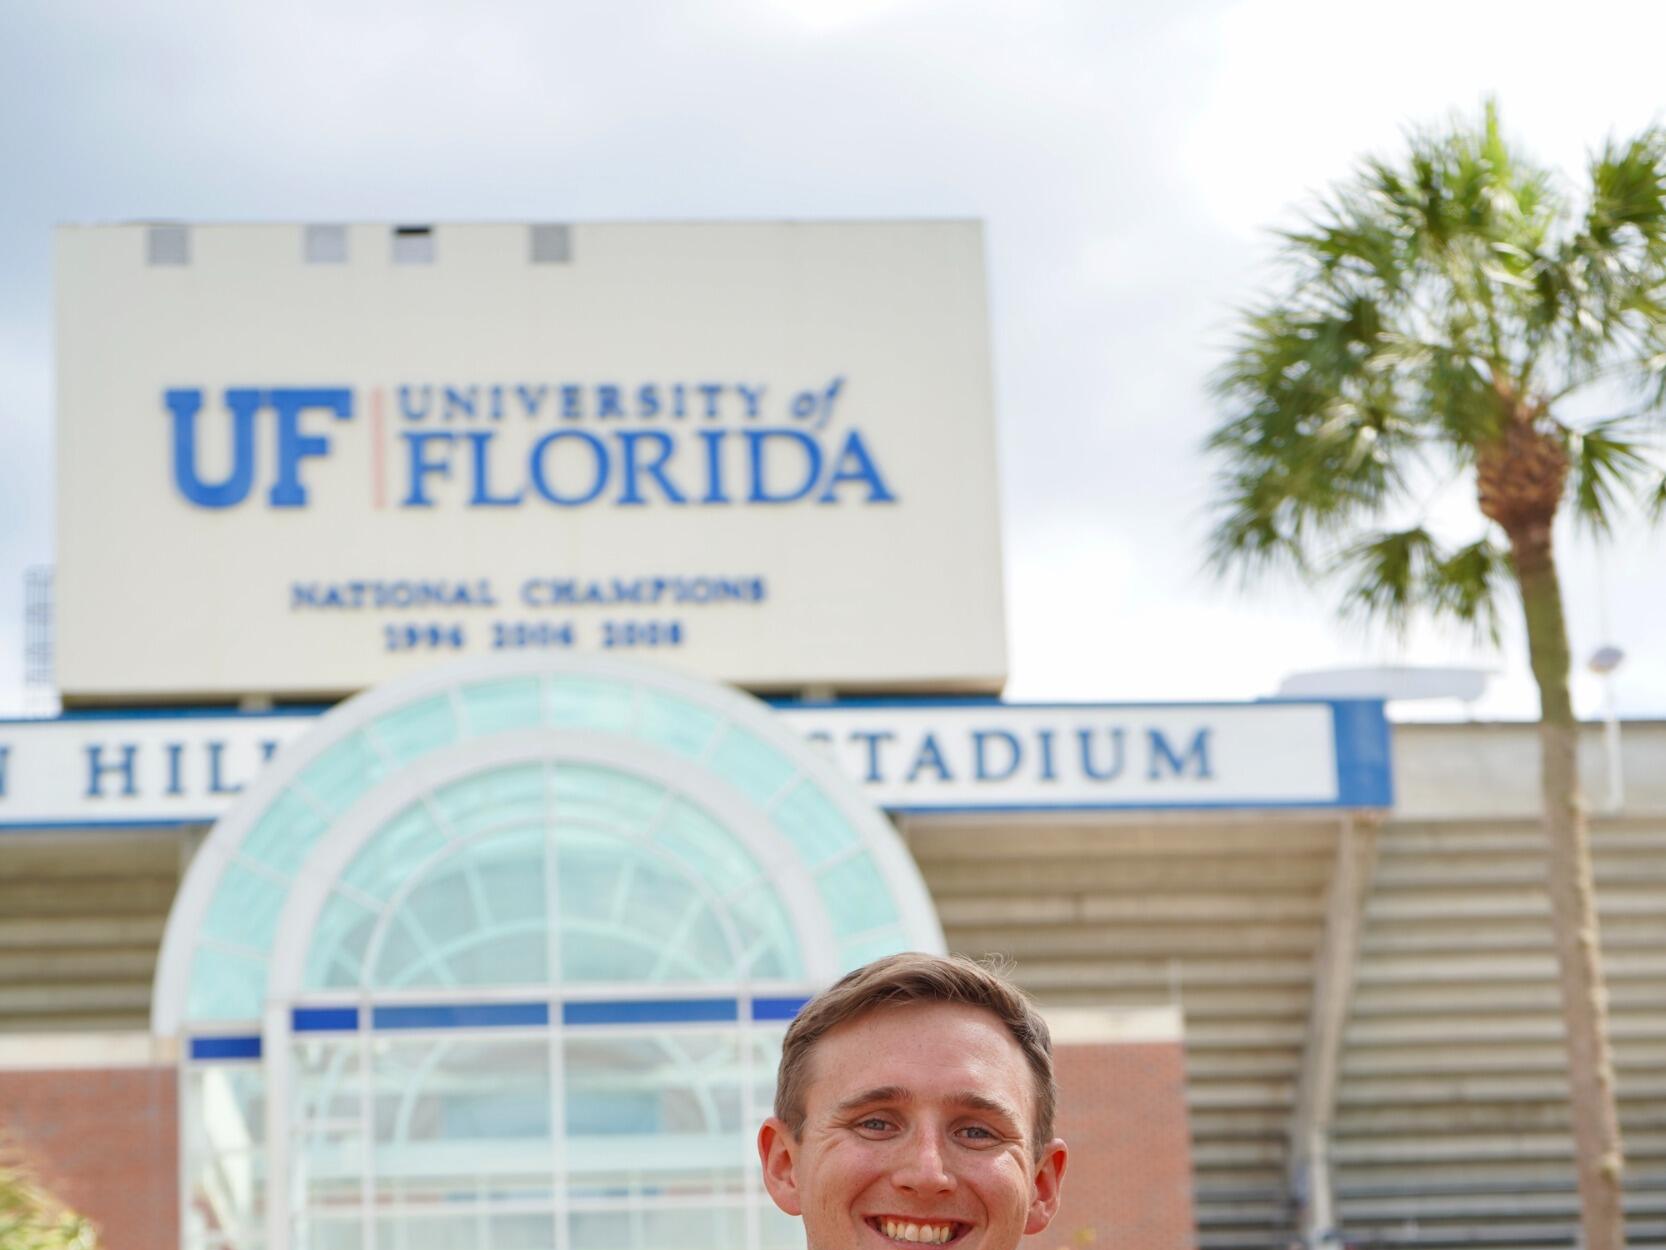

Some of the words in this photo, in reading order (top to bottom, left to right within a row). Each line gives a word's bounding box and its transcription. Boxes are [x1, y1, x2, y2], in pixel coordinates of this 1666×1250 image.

[397, 381, 767, 421] UNIVERSITY
[790, 374, 846, 430] of
[164, 387, 354, 510] UF
[398, 426, 898, 507] FLORIDA
[290, 577, 497, 610] NATIONAL
[520, 575, 766, 606] CHAMPIONS
[85, 741, 277, 798] HIL
[805, 726, 1216, 784] TADIUM
